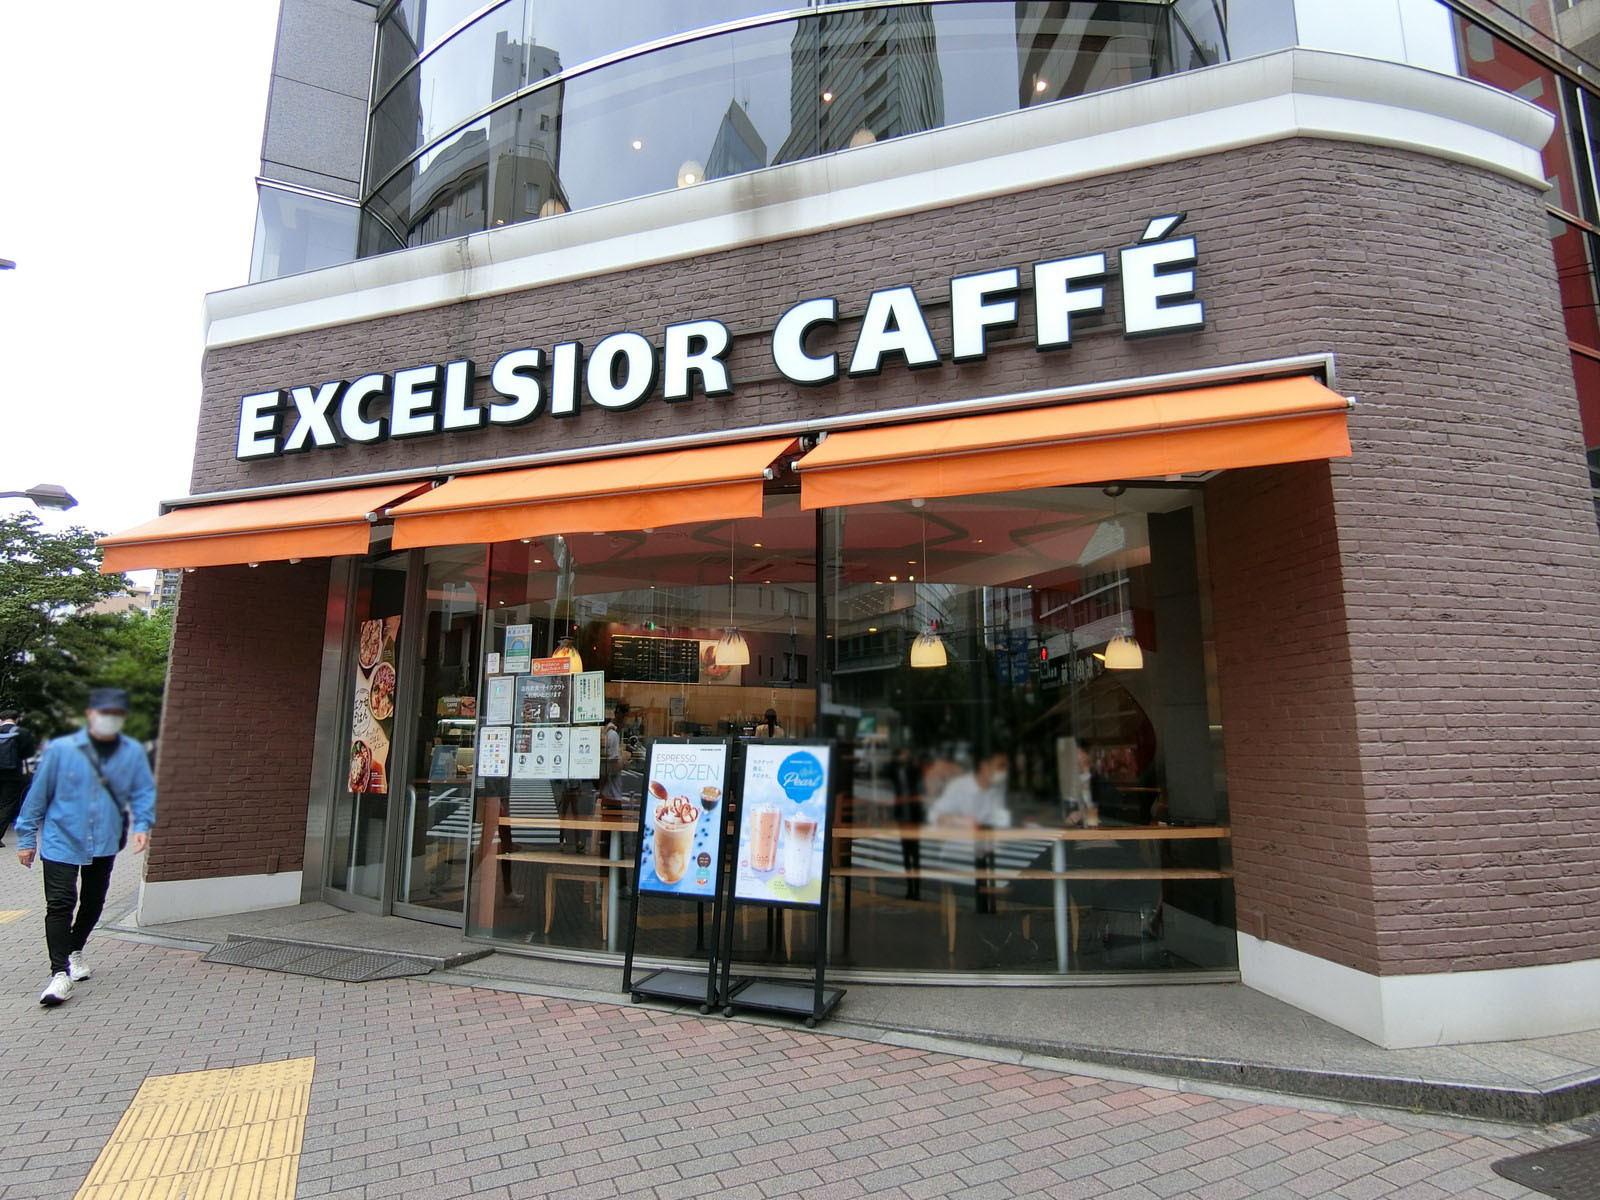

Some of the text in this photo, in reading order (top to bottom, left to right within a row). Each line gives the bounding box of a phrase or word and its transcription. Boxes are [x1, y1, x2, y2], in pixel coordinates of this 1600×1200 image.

[236, 212, 1205, 461] EXCELSIOR CAFFÉ
[656, 754, 697, 763] ESPRESSO
[654, 763, 720, 781] FROZEN
[783, 771, 822, 787] Pearl
